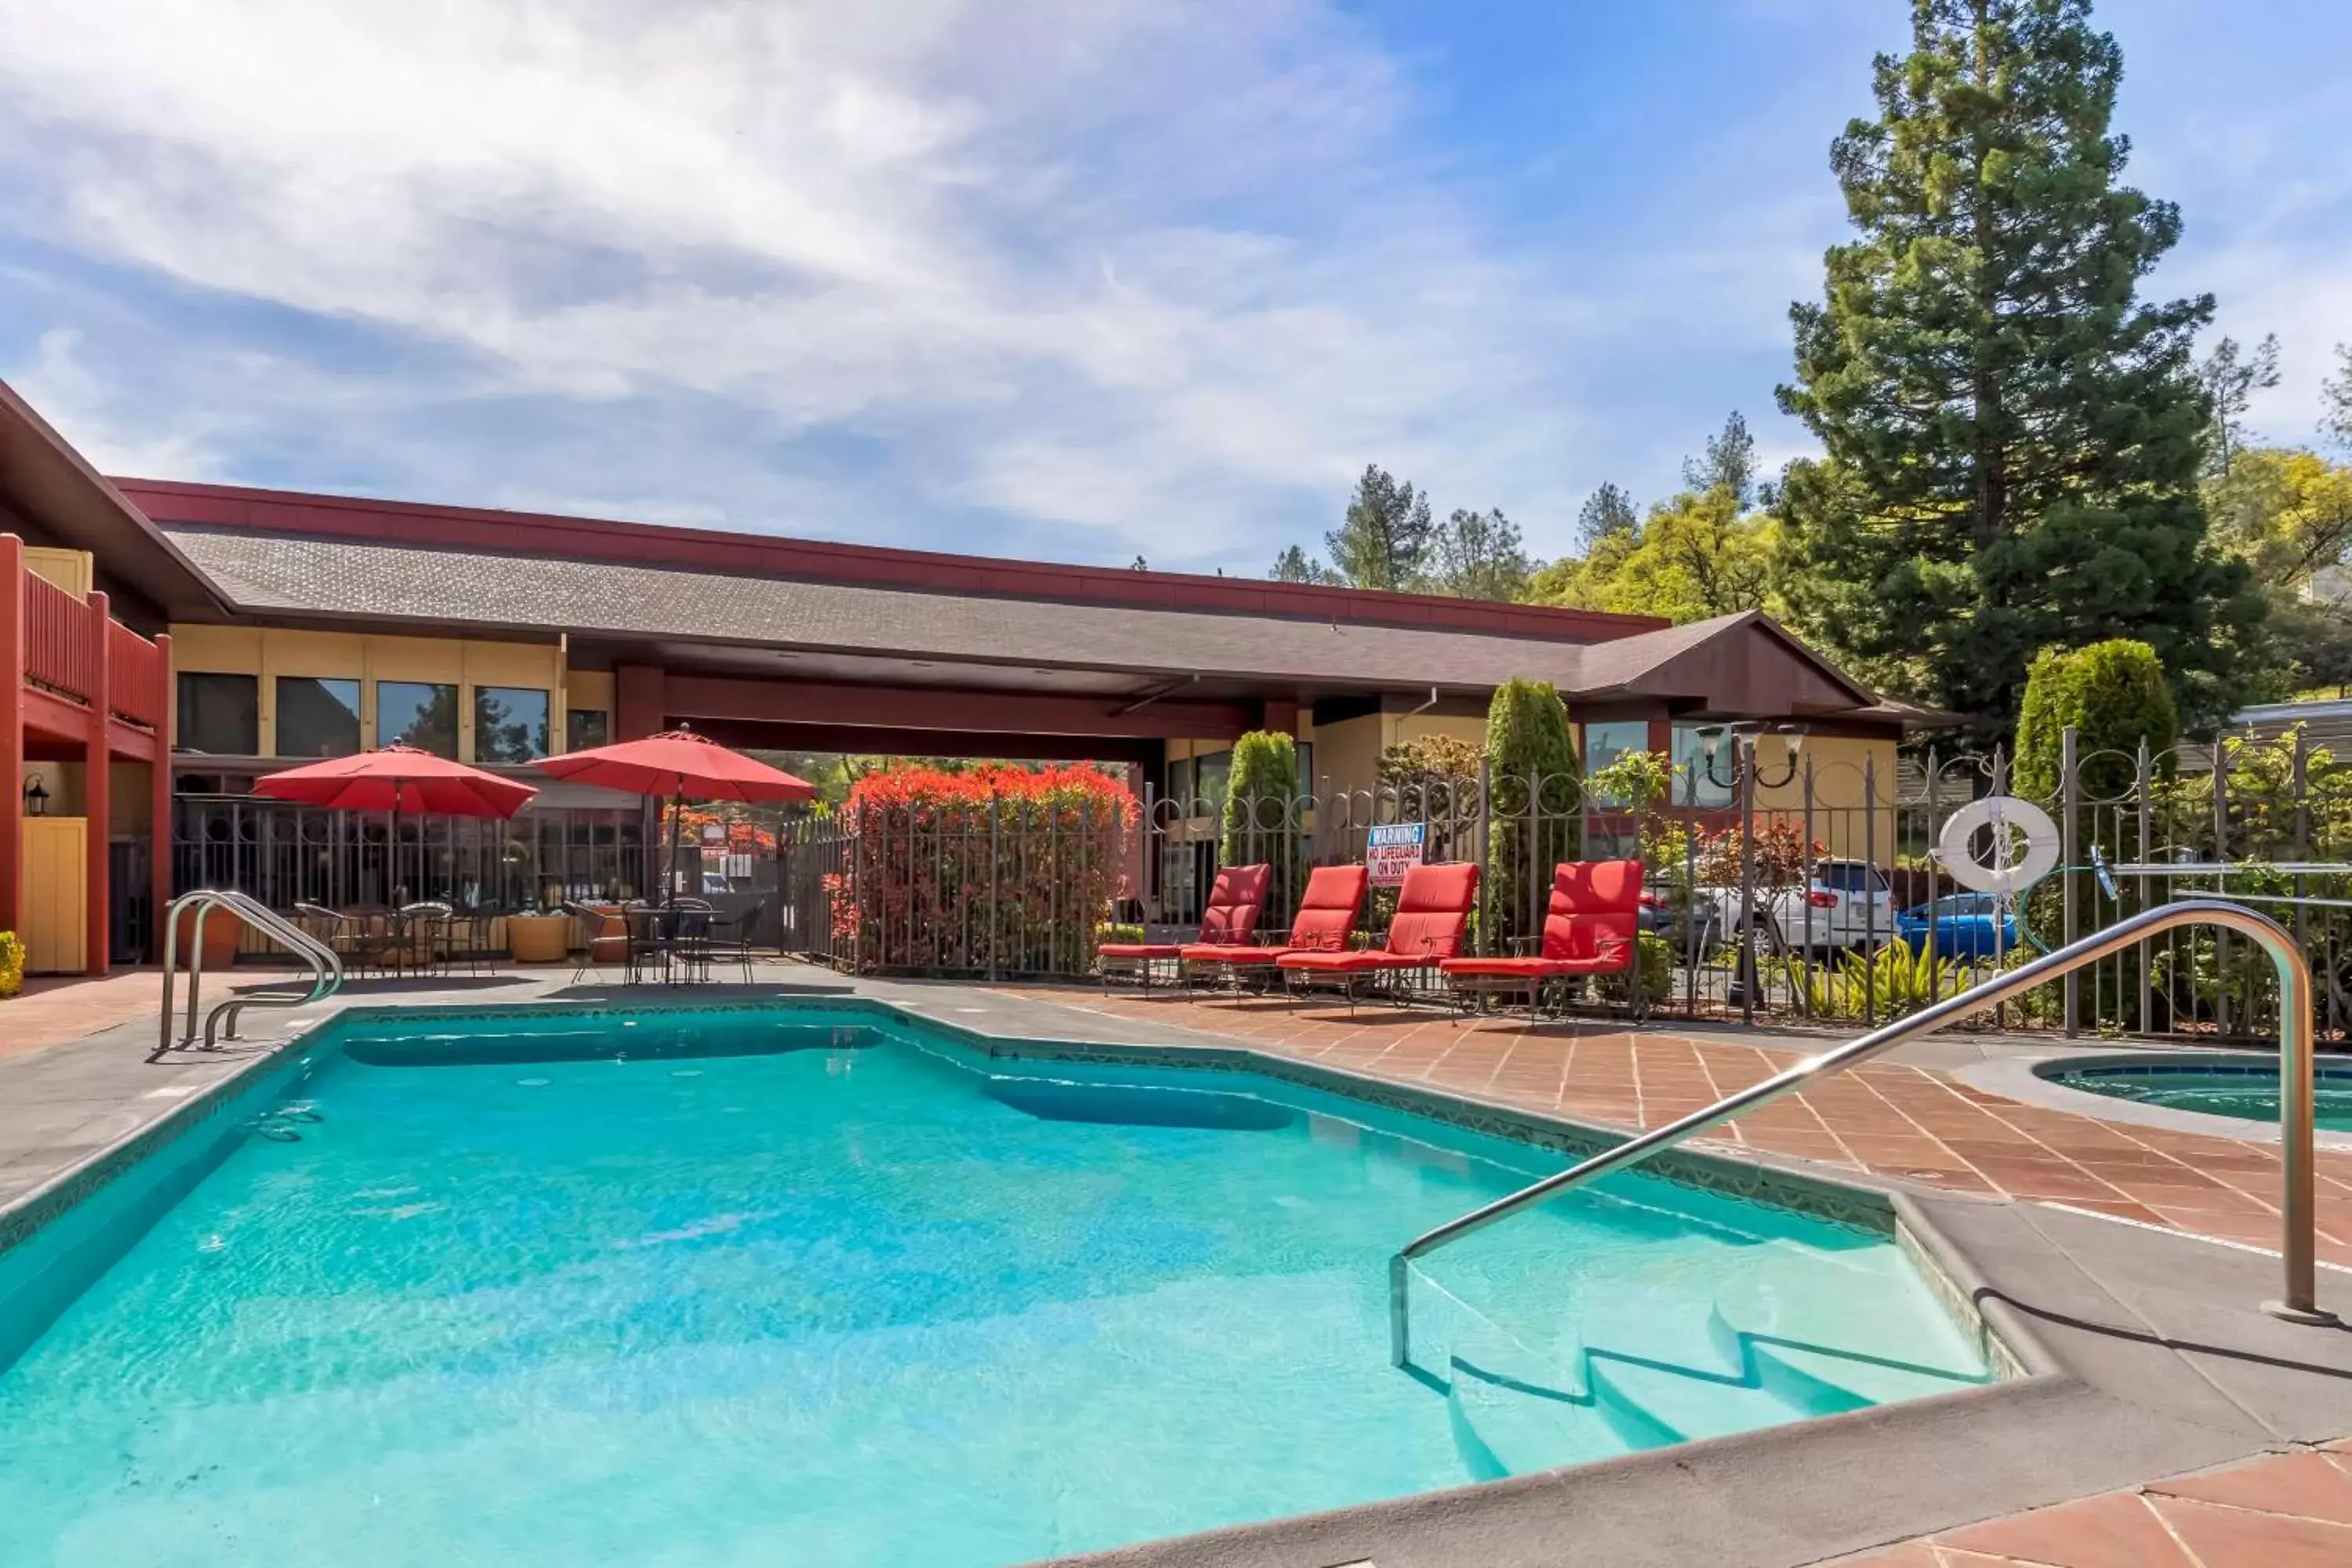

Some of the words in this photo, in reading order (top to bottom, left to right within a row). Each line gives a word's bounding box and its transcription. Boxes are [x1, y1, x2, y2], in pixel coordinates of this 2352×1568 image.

[1374, 826, 1419, 844] WARNING
[1369, 847, 1378, 860] NO
[1381, 845, 1420, 859] LIFEGUARD
[1378, 862, 1388, 874] ON
[1391, 861, 1410, 874] DUTY
